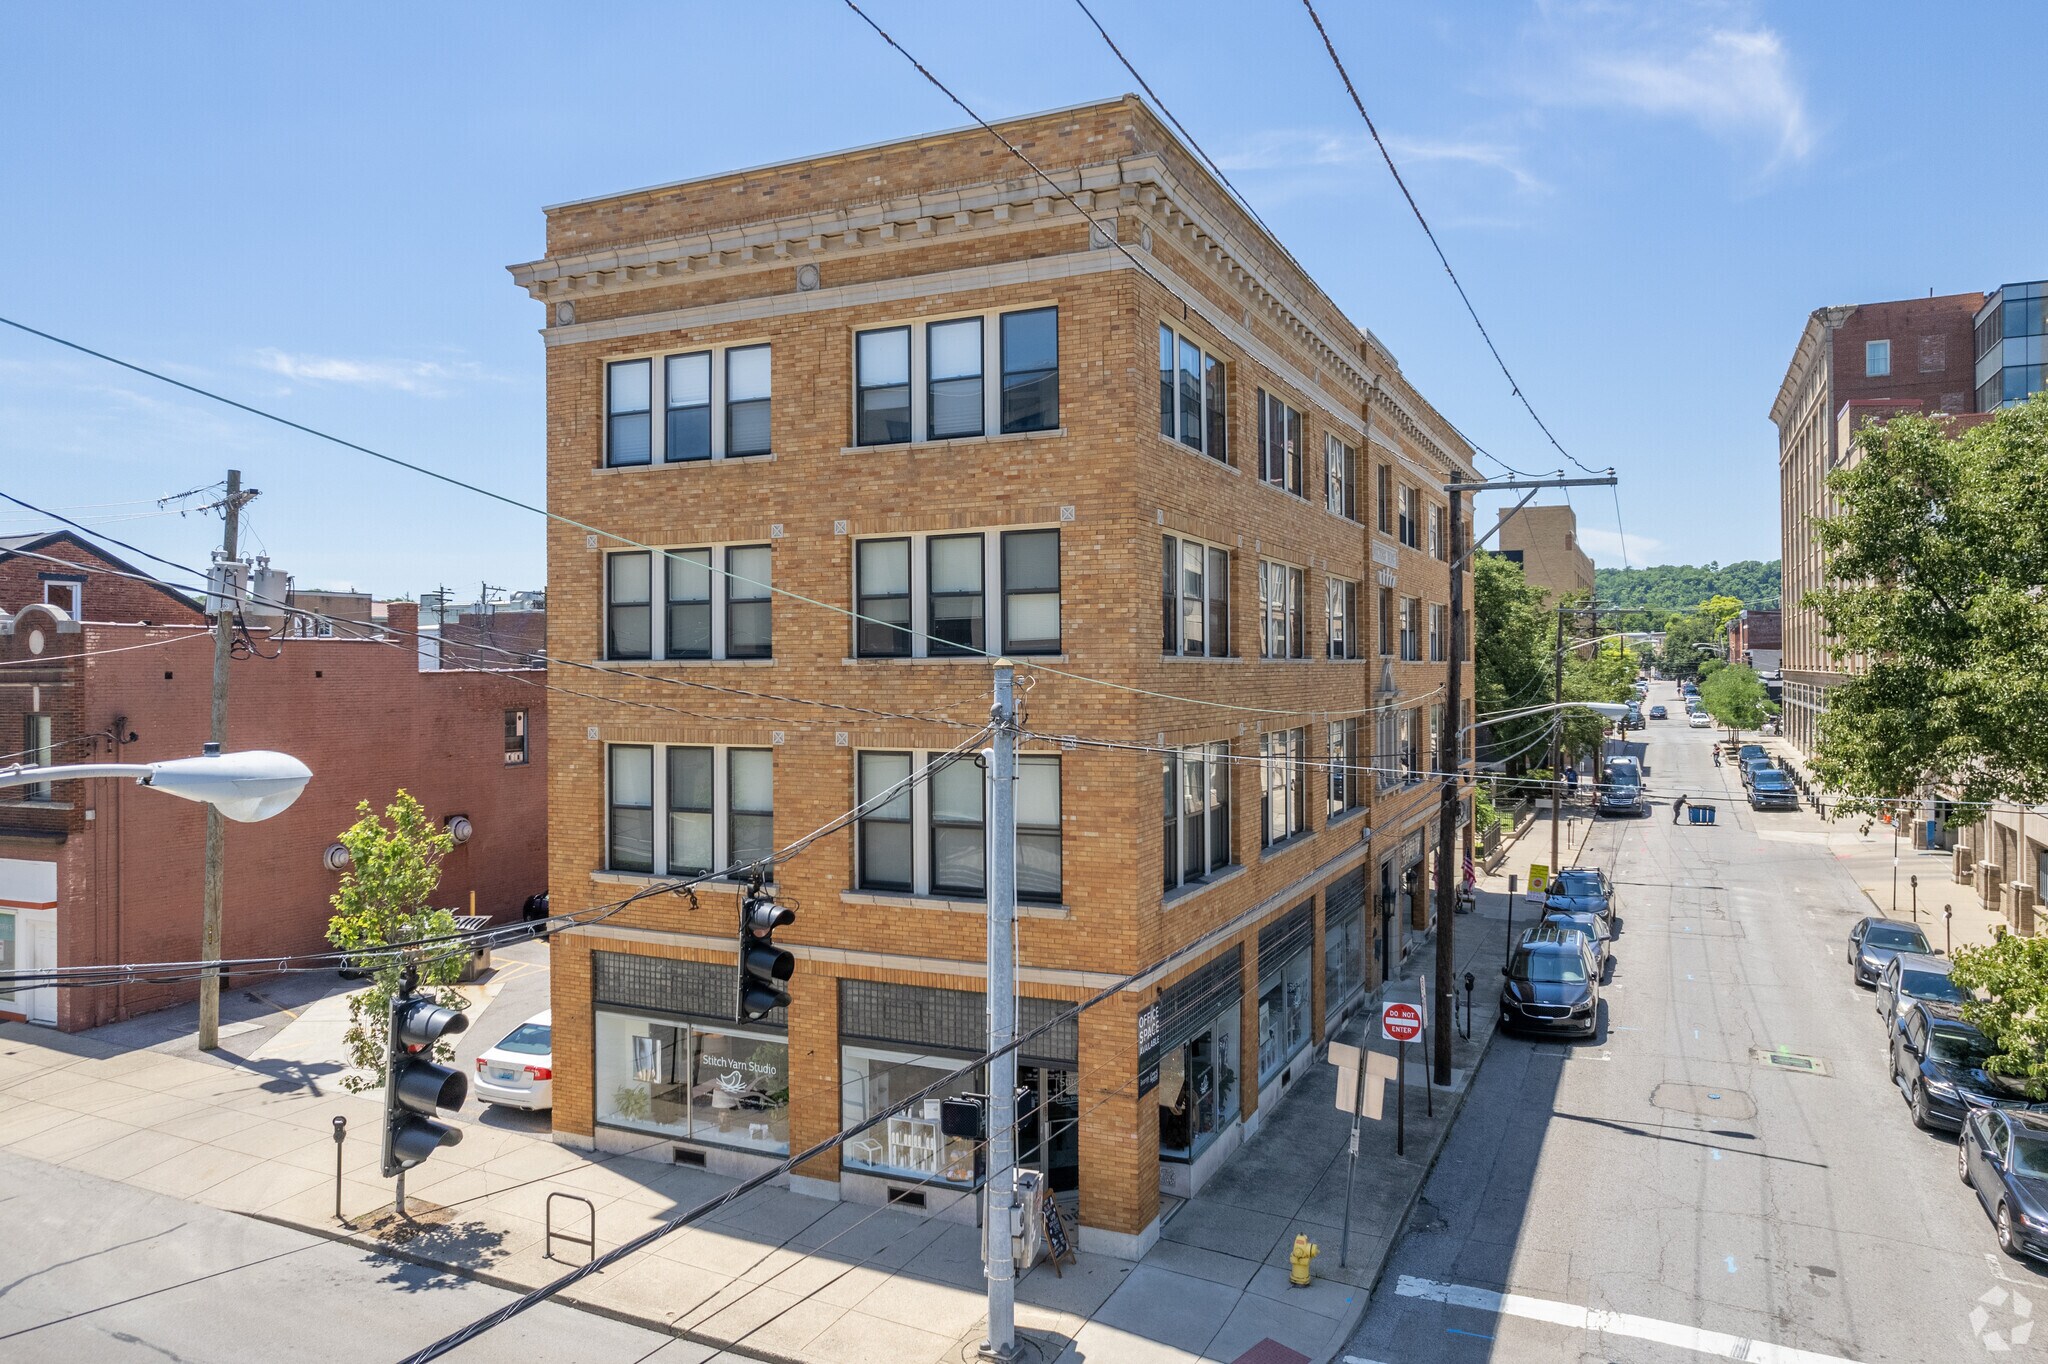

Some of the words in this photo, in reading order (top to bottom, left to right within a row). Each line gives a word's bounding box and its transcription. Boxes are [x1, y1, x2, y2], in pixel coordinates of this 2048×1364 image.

[1138, 1006, 1159, 1029] OFFICE
[1402, 1011, 1415, 1019] NOT
[1139, 1020, 1160, 1044] SPACE
[1391, 1025, 1412, 1034] ENTER
[702, 1054, 727, 1068] Stitch
[727, 1058, 747, 1071] Yarn
[748, 1061, 777, 1075] Studio
